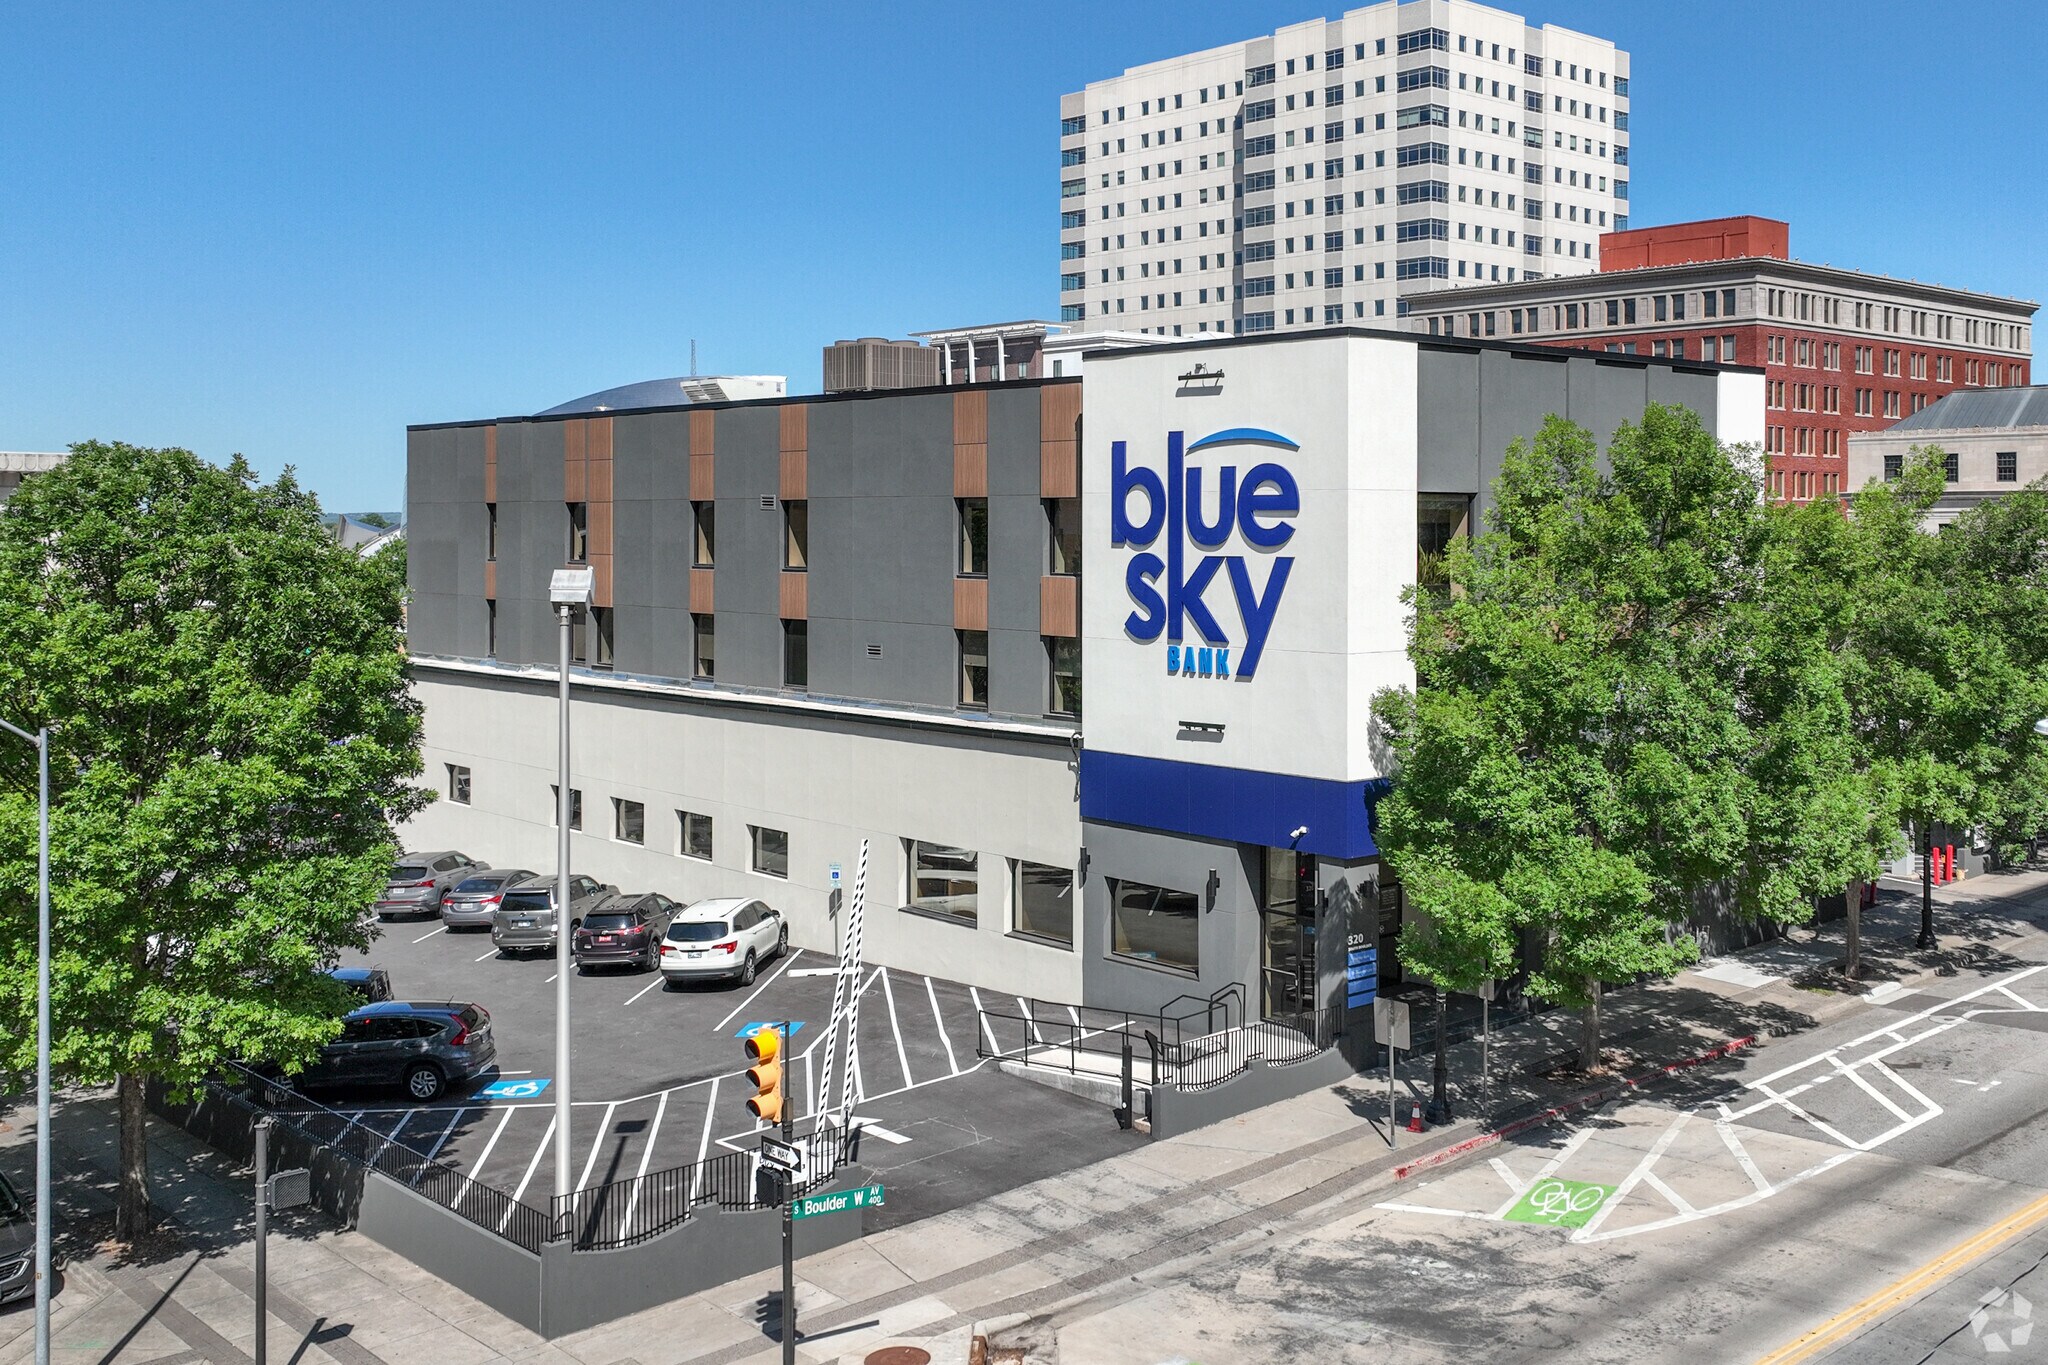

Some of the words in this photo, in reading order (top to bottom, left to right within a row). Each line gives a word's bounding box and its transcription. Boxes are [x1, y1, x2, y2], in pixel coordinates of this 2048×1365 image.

[1111, 430, 1300, 553] blue
[1124, 552, 1296, 683] sky
[1167, 646, 1230, 679] BANK
[1348, 933, 1363, 945] 320
[765, 1143, 776, 1156] ONE
[777, 1148, 789, 1161] WAY
[868, 1196, 881, 1205] 400
[870, 1186, 880, 1196] AV
[794, 1205, 799, 1215] S
[804, 1197, 847, 1215] Boulder
[854, 1191, 864, 1206] W
